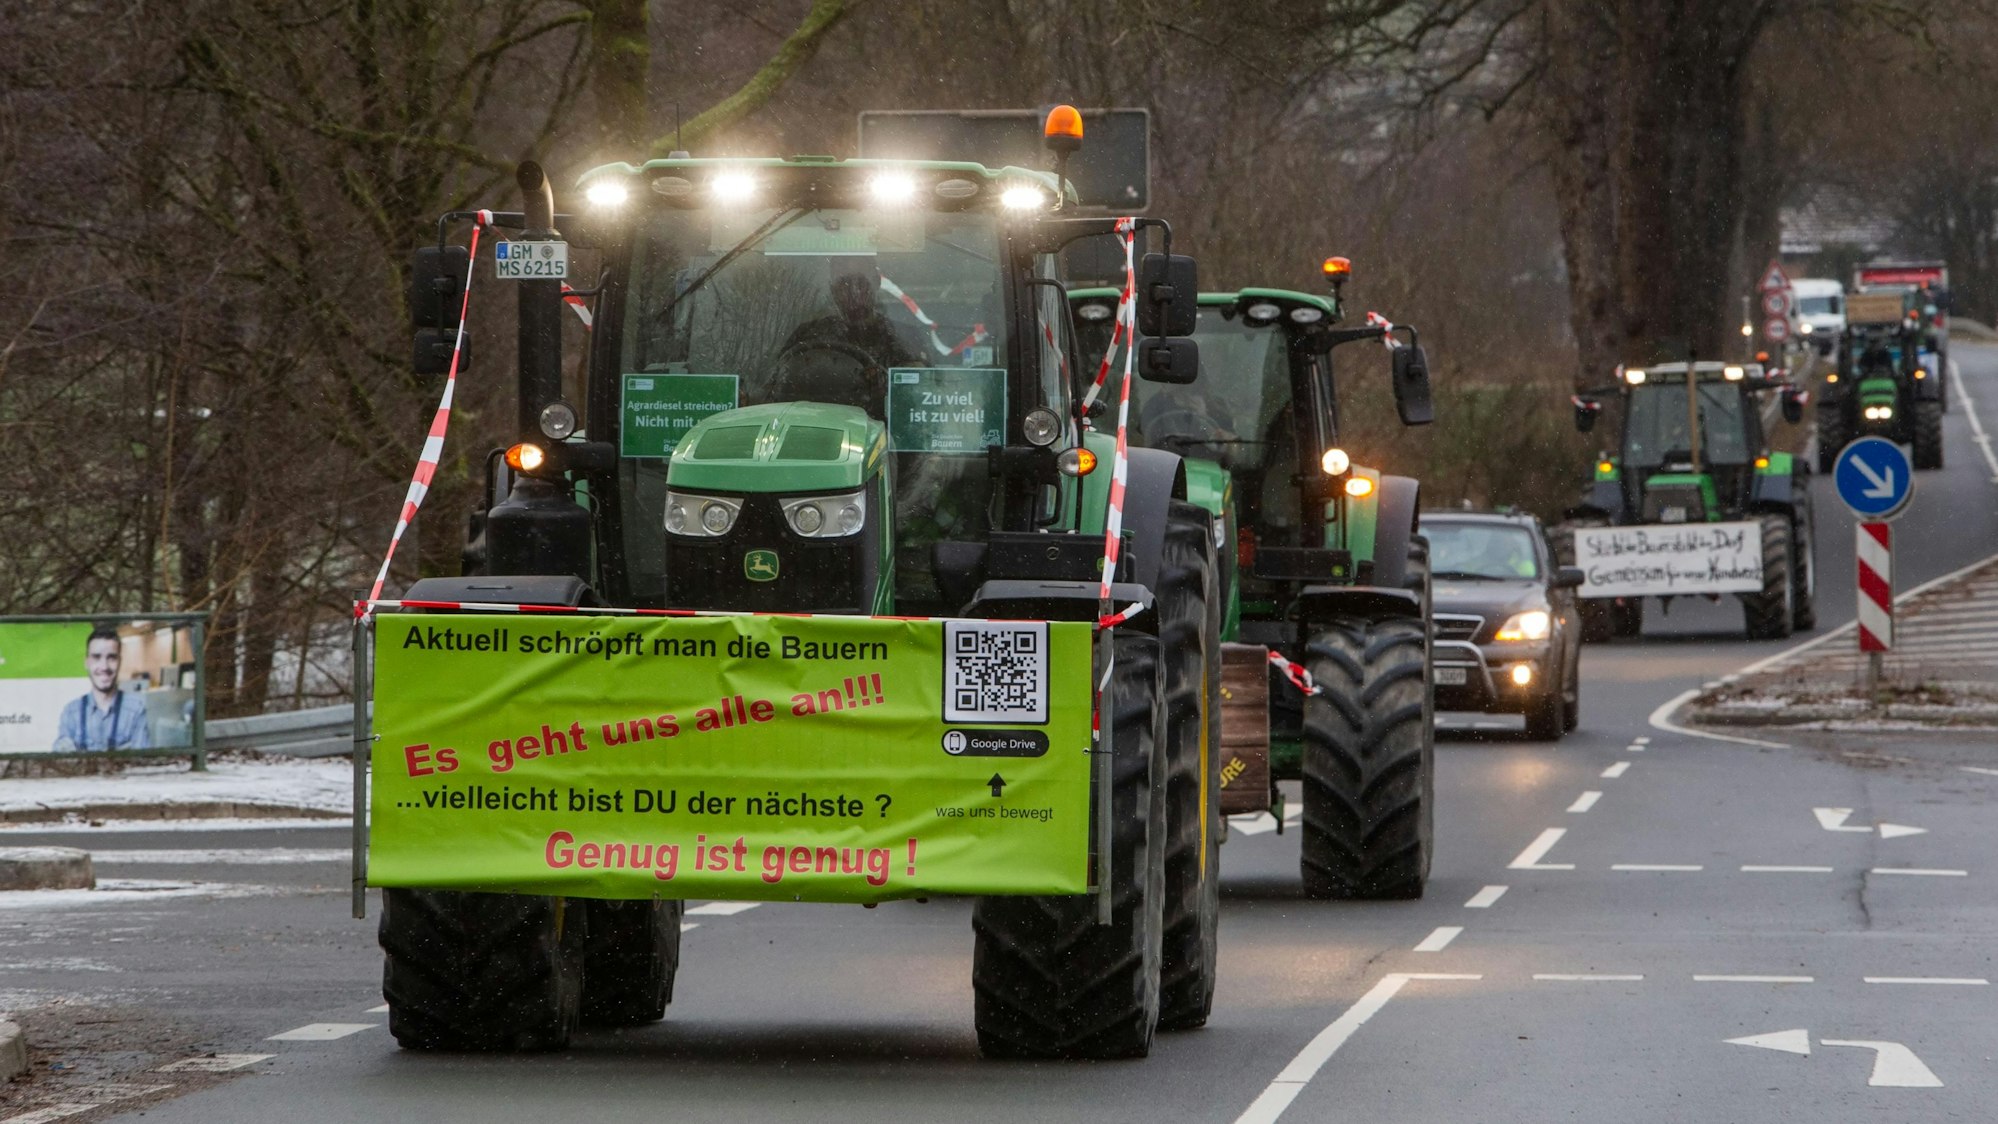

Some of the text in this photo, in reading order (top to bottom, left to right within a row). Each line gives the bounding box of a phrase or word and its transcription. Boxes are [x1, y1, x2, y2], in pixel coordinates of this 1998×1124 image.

[511, 245, 532, 259] GM
[499, 261, 564, 276] MS 6215
[627, 400, 733, 412] Agrardiesel streichen?
[922, 392, 973, 405] Zu viel
[635, 415, 669, 428] Nicht
[673, 416, 695, 428] mit
[909, 408, 985, 423] ist zu viel!
[932, 439, 963, 448] Bauern
[403, 626, 889, 660] Aktuell schröpft man die Bauern
[403, 672, 886, 778] Es geht uns alle an!!!
[971, 737, 1037, 752] Google Drive
[396, 786, 893, 818] ...vielleicht bist DU der nächste ?
[935, 805, 1054, 822] was uns bewegt
[544, 830, 919, 887] Genug ist genug !
